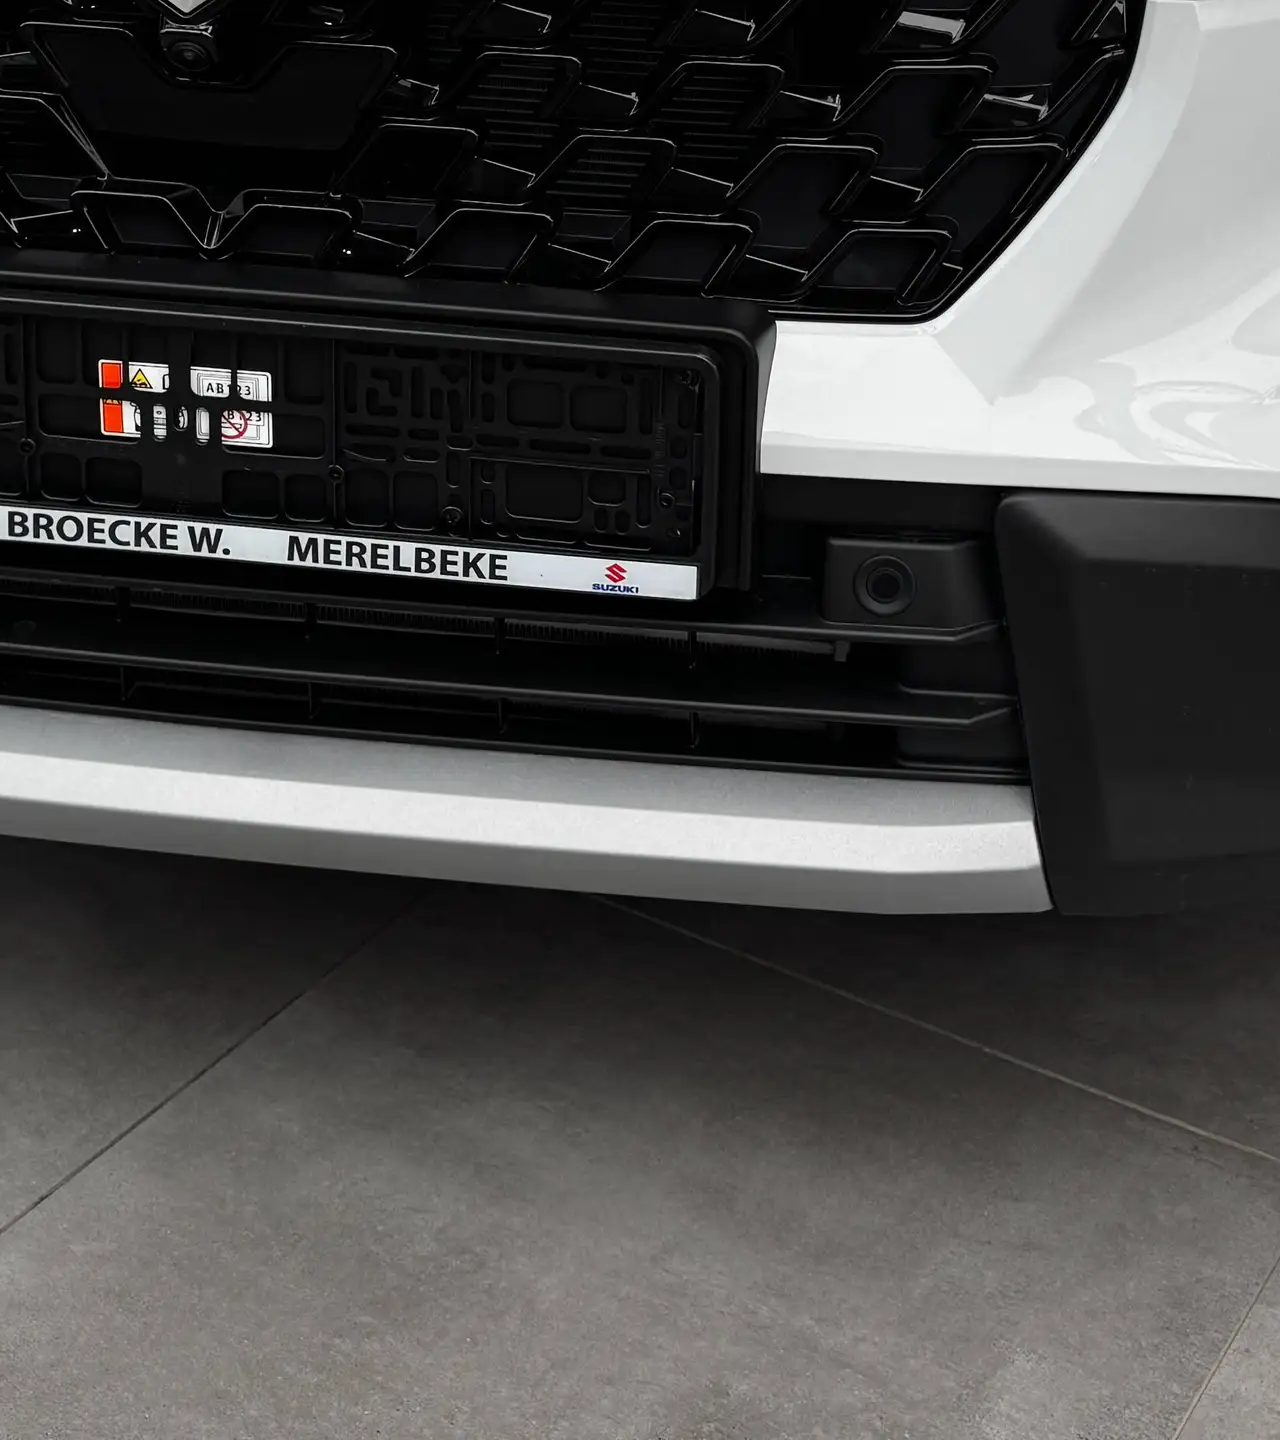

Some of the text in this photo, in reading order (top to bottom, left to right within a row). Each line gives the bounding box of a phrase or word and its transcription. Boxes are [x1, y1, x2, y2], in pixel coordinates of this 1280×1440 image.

[7, 511, 179, 551] BROECKE
[187, 525, 231, 556] W.
[287, 534, 509, 582] MERELBEKE
[591, 583, 639, 594] SUZUKI
